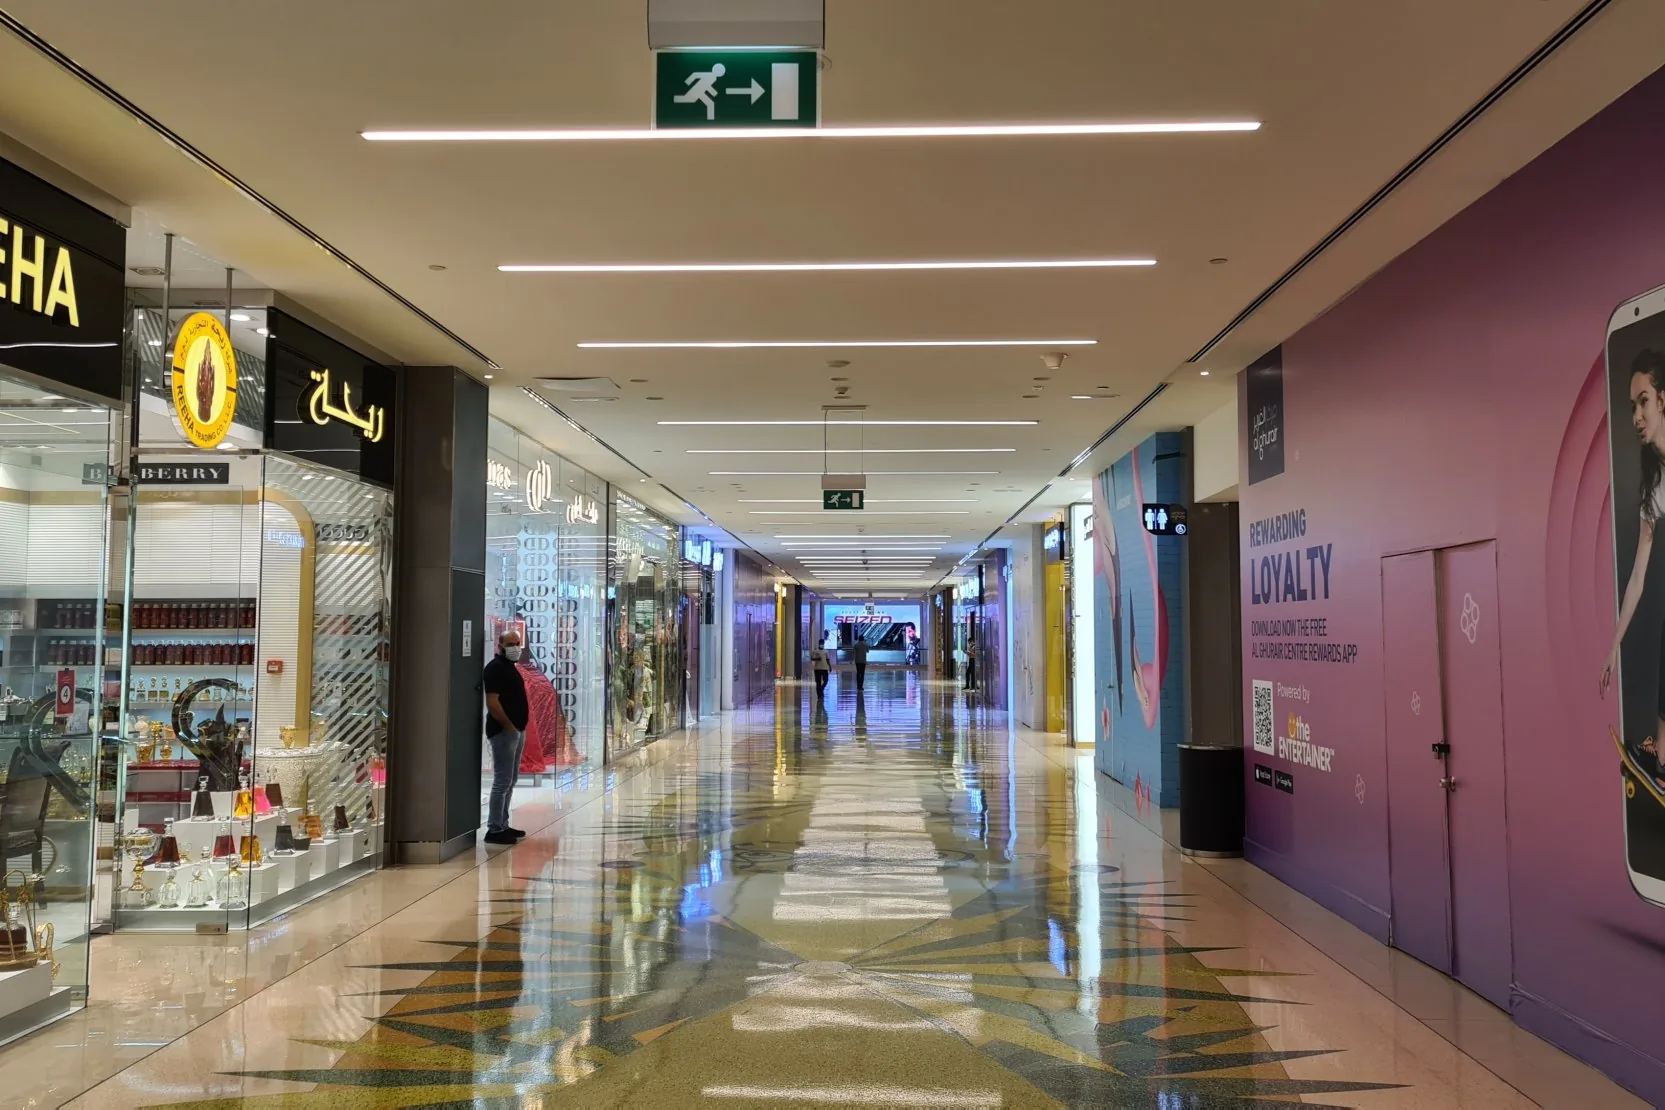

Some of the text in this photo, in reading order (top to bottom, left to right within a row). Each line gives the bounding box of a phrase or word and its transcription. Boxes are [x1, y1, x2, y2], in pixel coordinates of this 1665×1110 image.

[176, 384, 195, 434] REEHA
[195, 428, 217, 443] TRADING
[310, 368, 384, 443] ريحة
[1250, 508, 1306, 548] REWARDING
[1251, 543, 1332, 605] LOYALTY
[1251, 618, 1327, 637] DOWNLOAD NOW THE FREE
[1252, 642, 1357, 665] AL GHURAIR CENTRE REWARDS APP
[1277, 682, 1310, 704] Powered by
[1295, 715, 1310, 741] the
